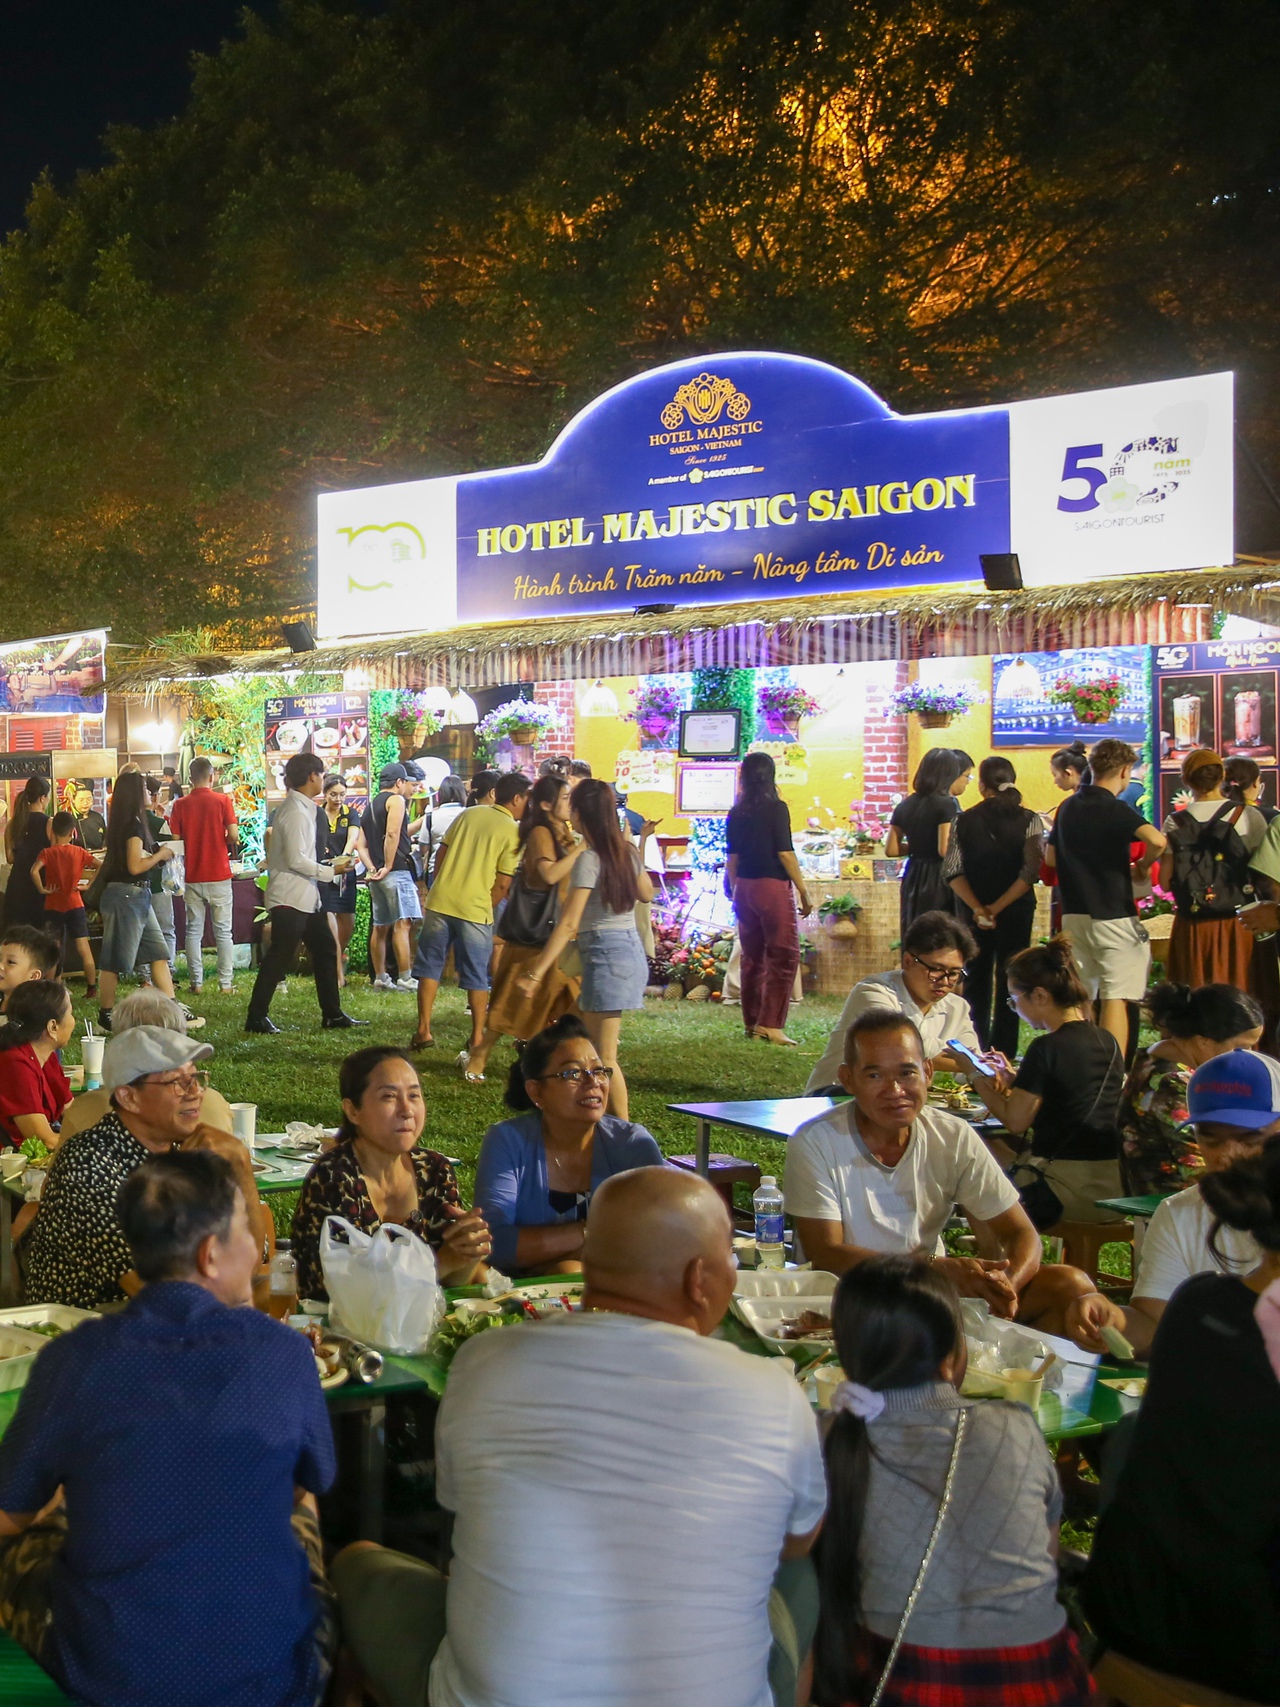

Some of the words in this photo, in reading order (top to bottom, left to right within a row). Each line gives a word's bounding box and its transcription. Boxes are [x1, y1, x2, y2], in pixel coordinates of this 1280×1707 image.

[649, 430, 694, 446] HOTEL
[697, 421, 763, 440] MAJESTIC
[669, 444, 700, 455] SAIGON
[705, 439, 742, 450] VIETNAM
[684, 455, 707, 465] Since
[709, 453, 728, 463] 1925
[654, 475, 680, 484] member
[680, 473, 687, 481] of
[477, 516, 594, 557] HOTEL
[602, 493, 798, 544] MAJESTIC
[807, 473, 976, 522] SAIGON
[1074, 513, 1165, 531] SAIGONTOURIST
[513, 572, 565, 600] Hành
[568, 567, 617, 595] trình
[624, 564, 675, 591] Trăm
[679, 564, 725, 585] năm
[753, 552, 810, 582] Nâng
[815, 549, 860, 573] tầm
[867, 541, 896, 571] Di
[900, 543, 944, 566] sản
[1207, 641, 1240, 657] MÓN
[615, 767, 630, 777] 10
